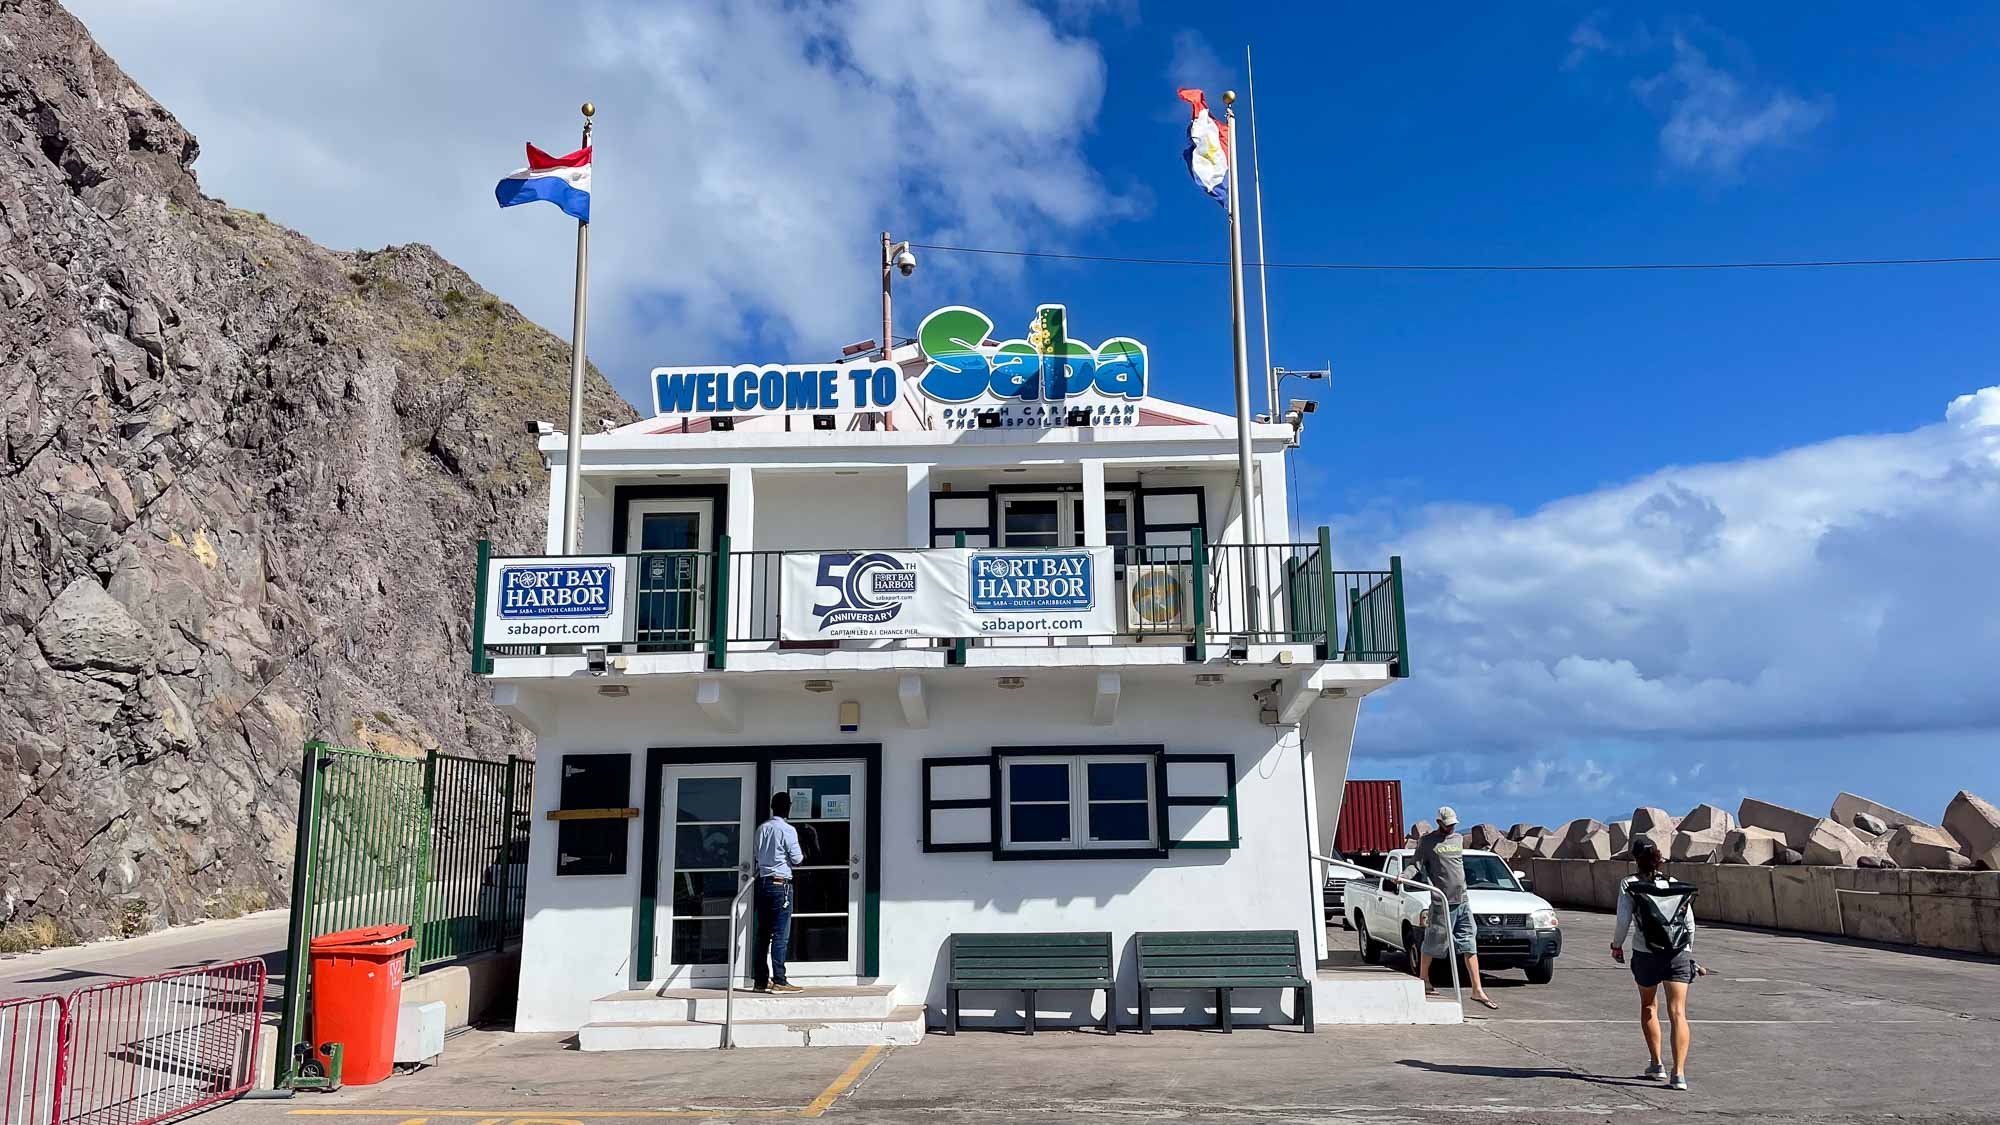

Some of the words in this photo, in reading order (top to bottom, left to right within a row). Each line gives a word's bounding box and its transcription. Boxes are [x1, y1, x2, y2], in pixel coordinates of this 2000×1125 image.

[918, 304, 1148, 402] Saba
[656, 369, 839, 413] WELCOME
[848, 366, 897, 408] TO
[945, 418, 976, 430] THE
[1091, 415, 1132, 427] UEEN
[978, 557, 1038, 577] FORT
[1041, 557, 1087, 577] BAY
[507, 570, 563, 588] FORT
[566, 569, 607, 587] BAY
[874, 580, 915, 589] HARBOR
[898, 573, 915, 581] BAY
[977, 577, 1086, 598] HARBOR
[506, 587, 605, 607] HARBOR
[829, 610, 893, 624] ANNIVERSARY
[981, 617, 1083, 633] sabaport.com
[507, 622, 600, 637] sabaport.com
